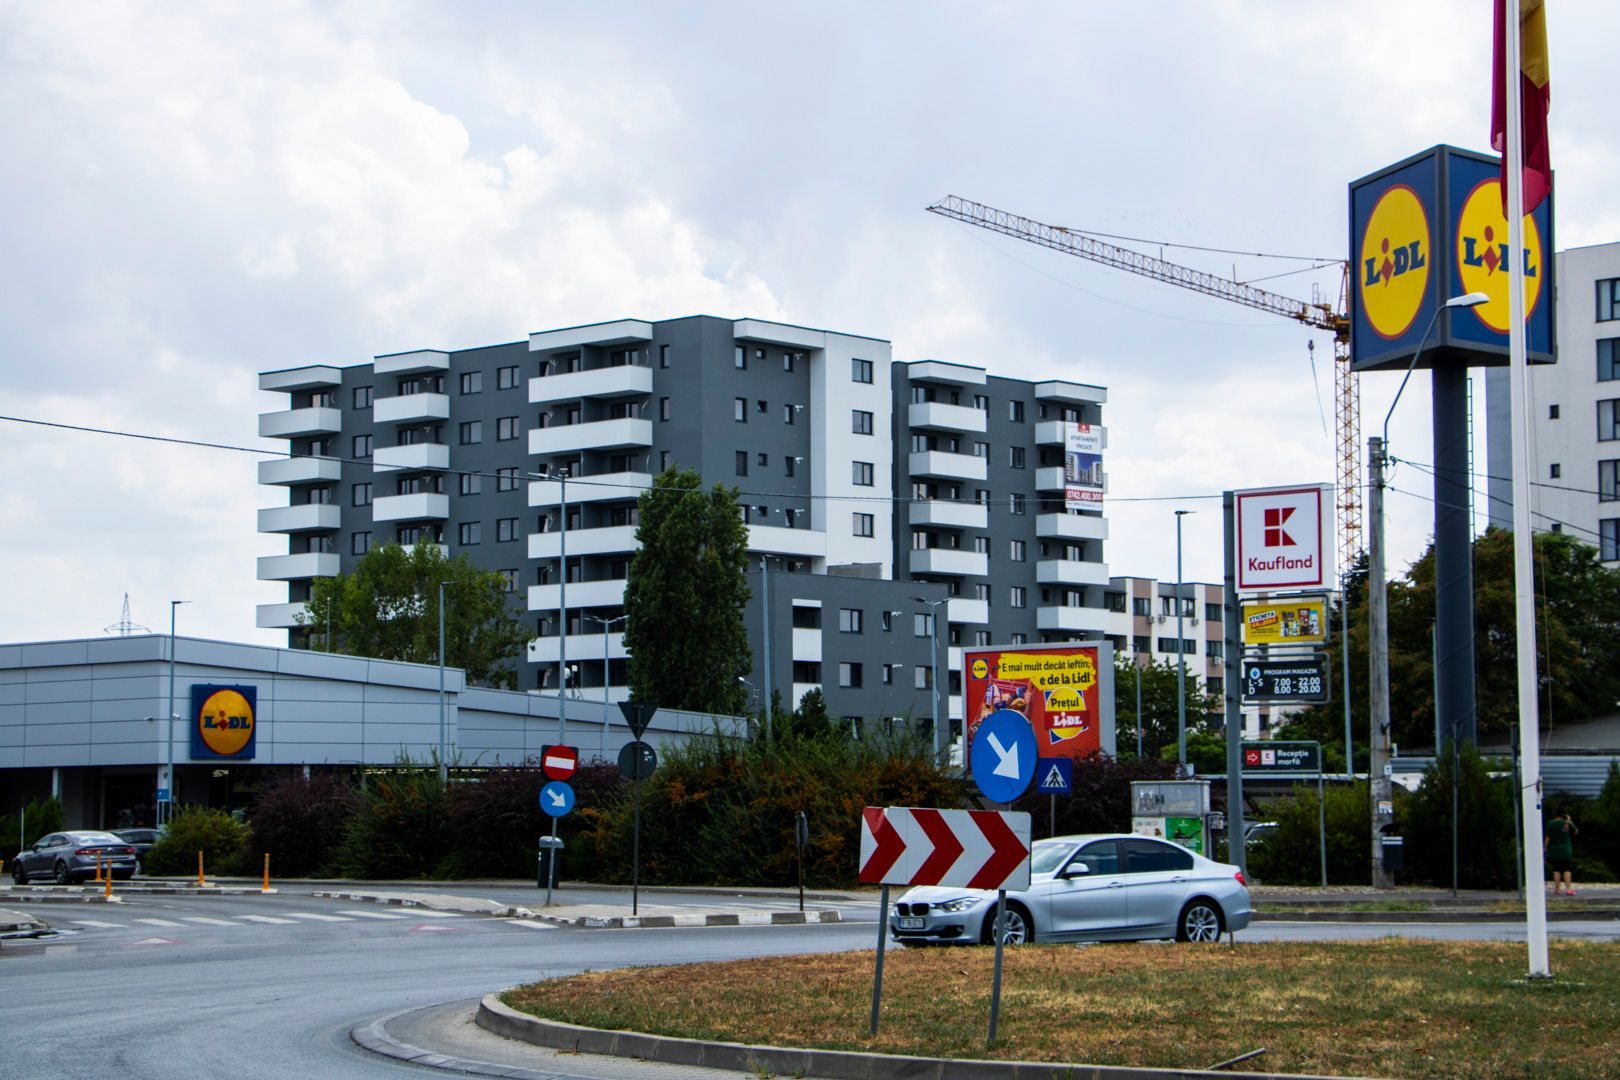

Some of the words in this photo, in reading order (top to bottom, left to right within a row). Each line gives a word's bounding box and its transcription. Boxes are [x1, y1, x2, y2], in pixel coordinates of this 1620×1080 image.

[1248, 554, 1313, 571] Kaufland
[1002, 663, 1007, 672] E
[1008, 662, 1023, 672] mai
[1024, 661, 1042, 671] mult
[1044, 660, 1066, 670] decât
[1040, 677, 1045, 685] e
[1047, 676, 1060, 685] de
[1061, 675, 1070, 684] la
[1072, 672, 1091, 683] Lidl
[1274, 678, 1291, 686] 7.00
[1298, 677, 1321, 685] 22.00
[1274, 686, 1291, 694] 8.00
[1298, 685, 1321, 693] 20.00
[1051, 697, 1079, 710] Prețul
[1277, 749, 1309, 759] Recepție
